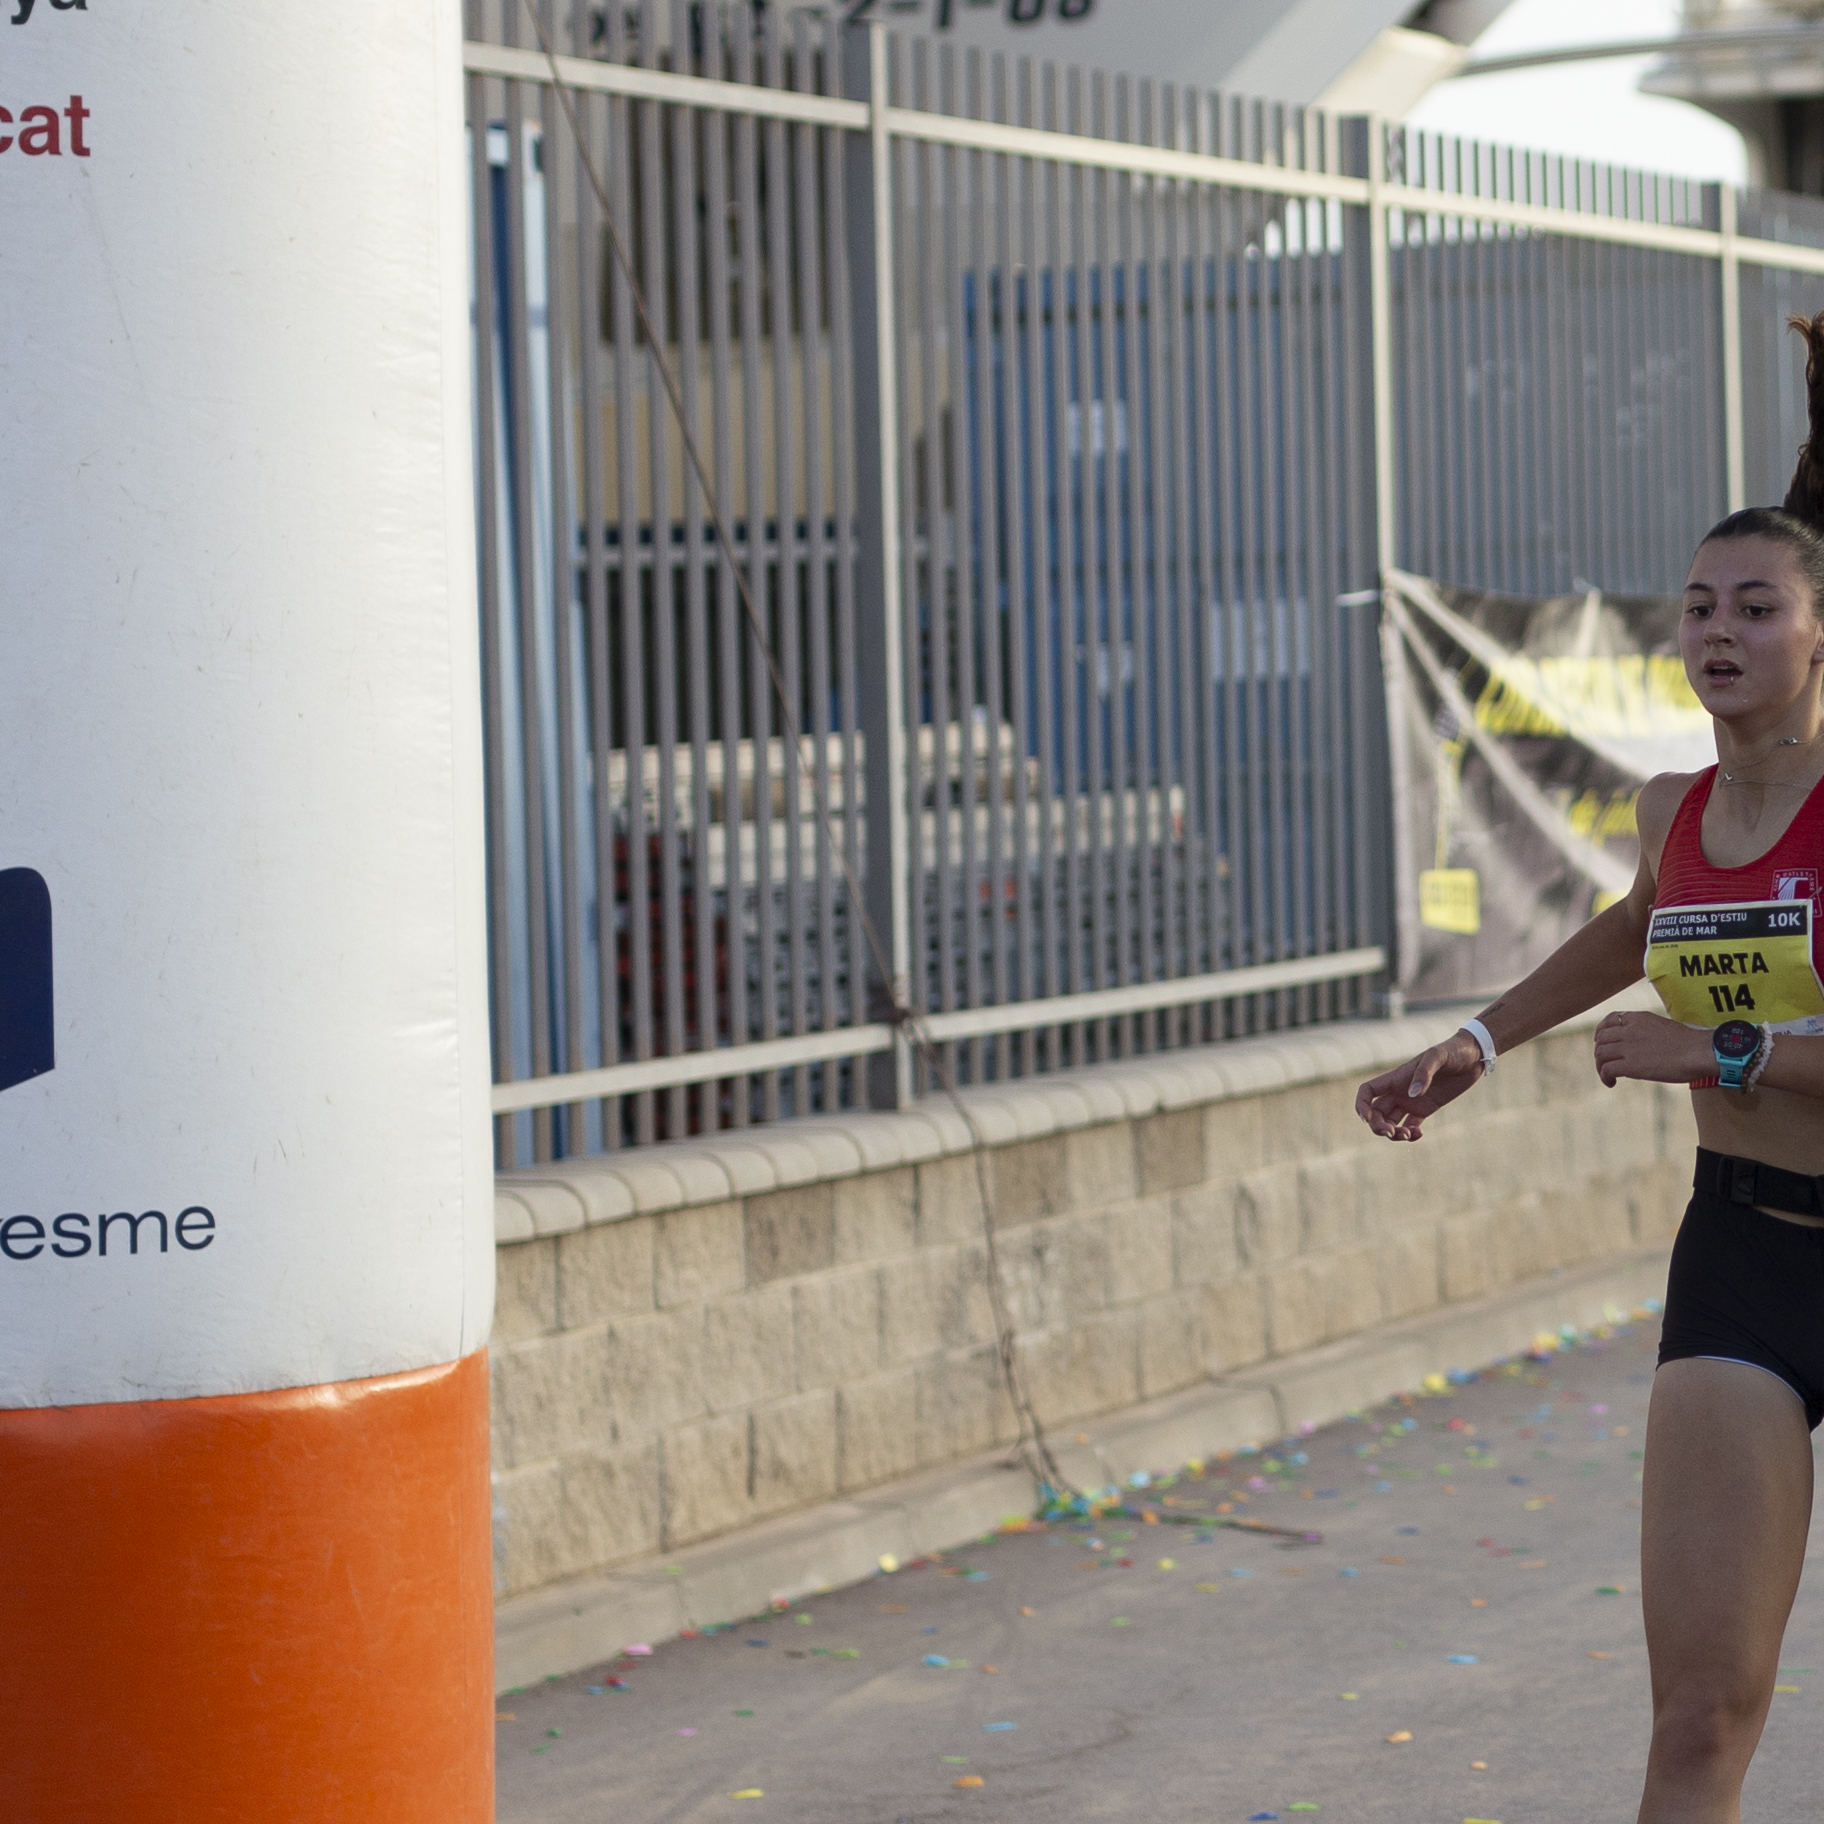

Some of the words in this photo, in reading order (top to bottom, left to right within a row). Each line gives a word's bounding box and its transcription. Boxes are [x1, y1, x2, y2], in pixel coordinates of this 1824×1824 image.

[1679, 914, 1708, 925] CURSA
[1710, 912, 1748, 923] D'ESTIU
[1768, 912, 1801, 927] 10K
[1682, 927, 1694, 936] DE
[1696, 926, 1718, 935] MAR
[1679, 952, 1770, 977] MARTA
[1708, 983, 1756, 1013] 114
[0, 1205, 217, 1260] esme
